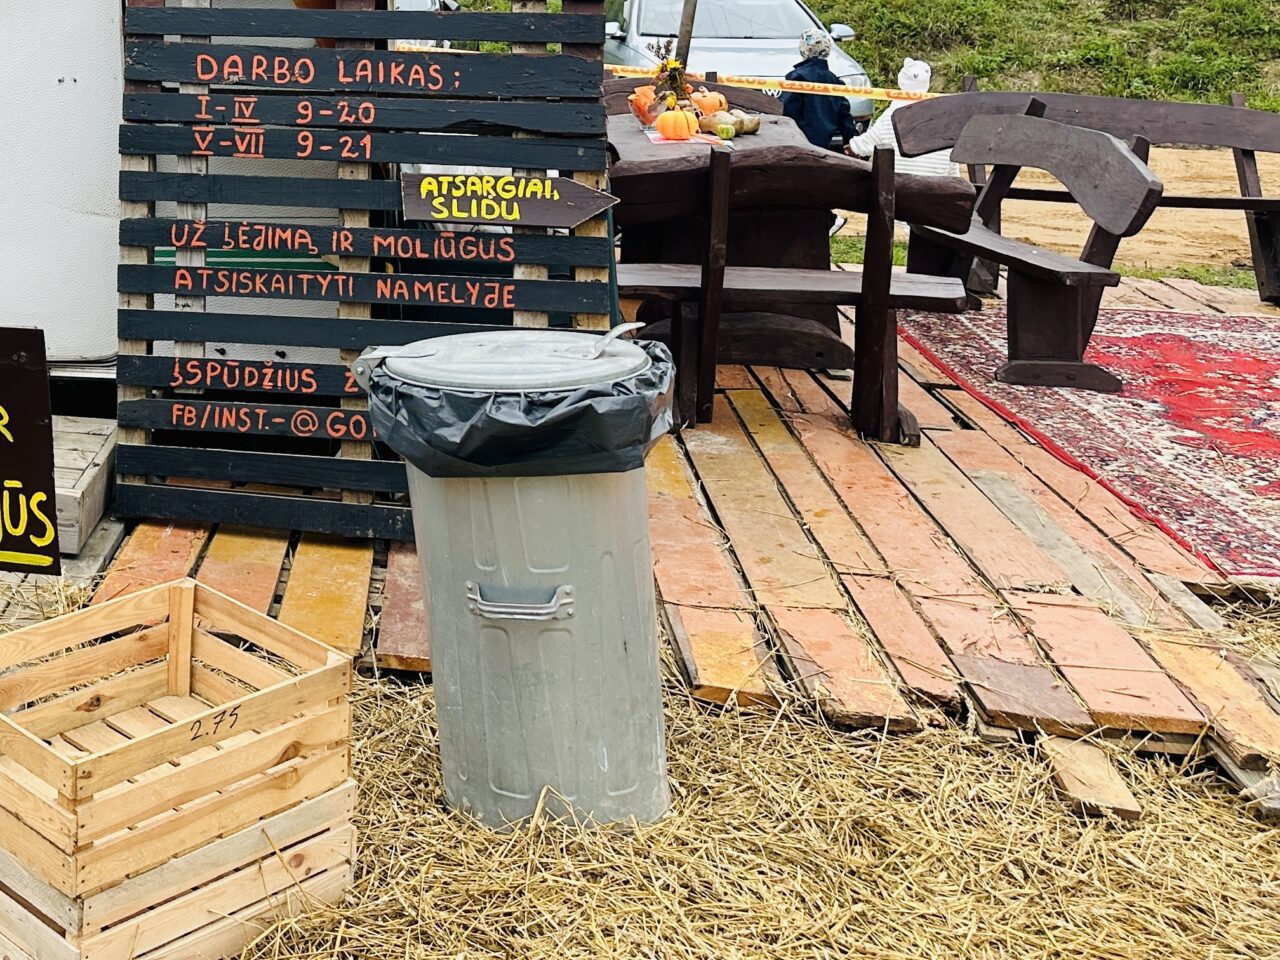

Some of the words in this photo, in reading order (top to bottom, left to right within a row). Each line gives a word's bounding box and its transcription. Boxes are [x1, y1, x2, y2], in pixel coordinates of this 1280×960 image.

[196, 54, 315, 84] DARBO
[295, 100, 376, 124] 9-20
[295, 130, 373, 159] 9-21
[431, 196, 521, 221] SLIDU
[171, 219, 208, 247] UŽ
[331, 230, 354, 253] IR
[372, 232, 516, 262] MOLIŪGUS
[174, 268, 354, 297] ATSISKAITYTI
[376, 278, 516, 308] NAMELYJE
